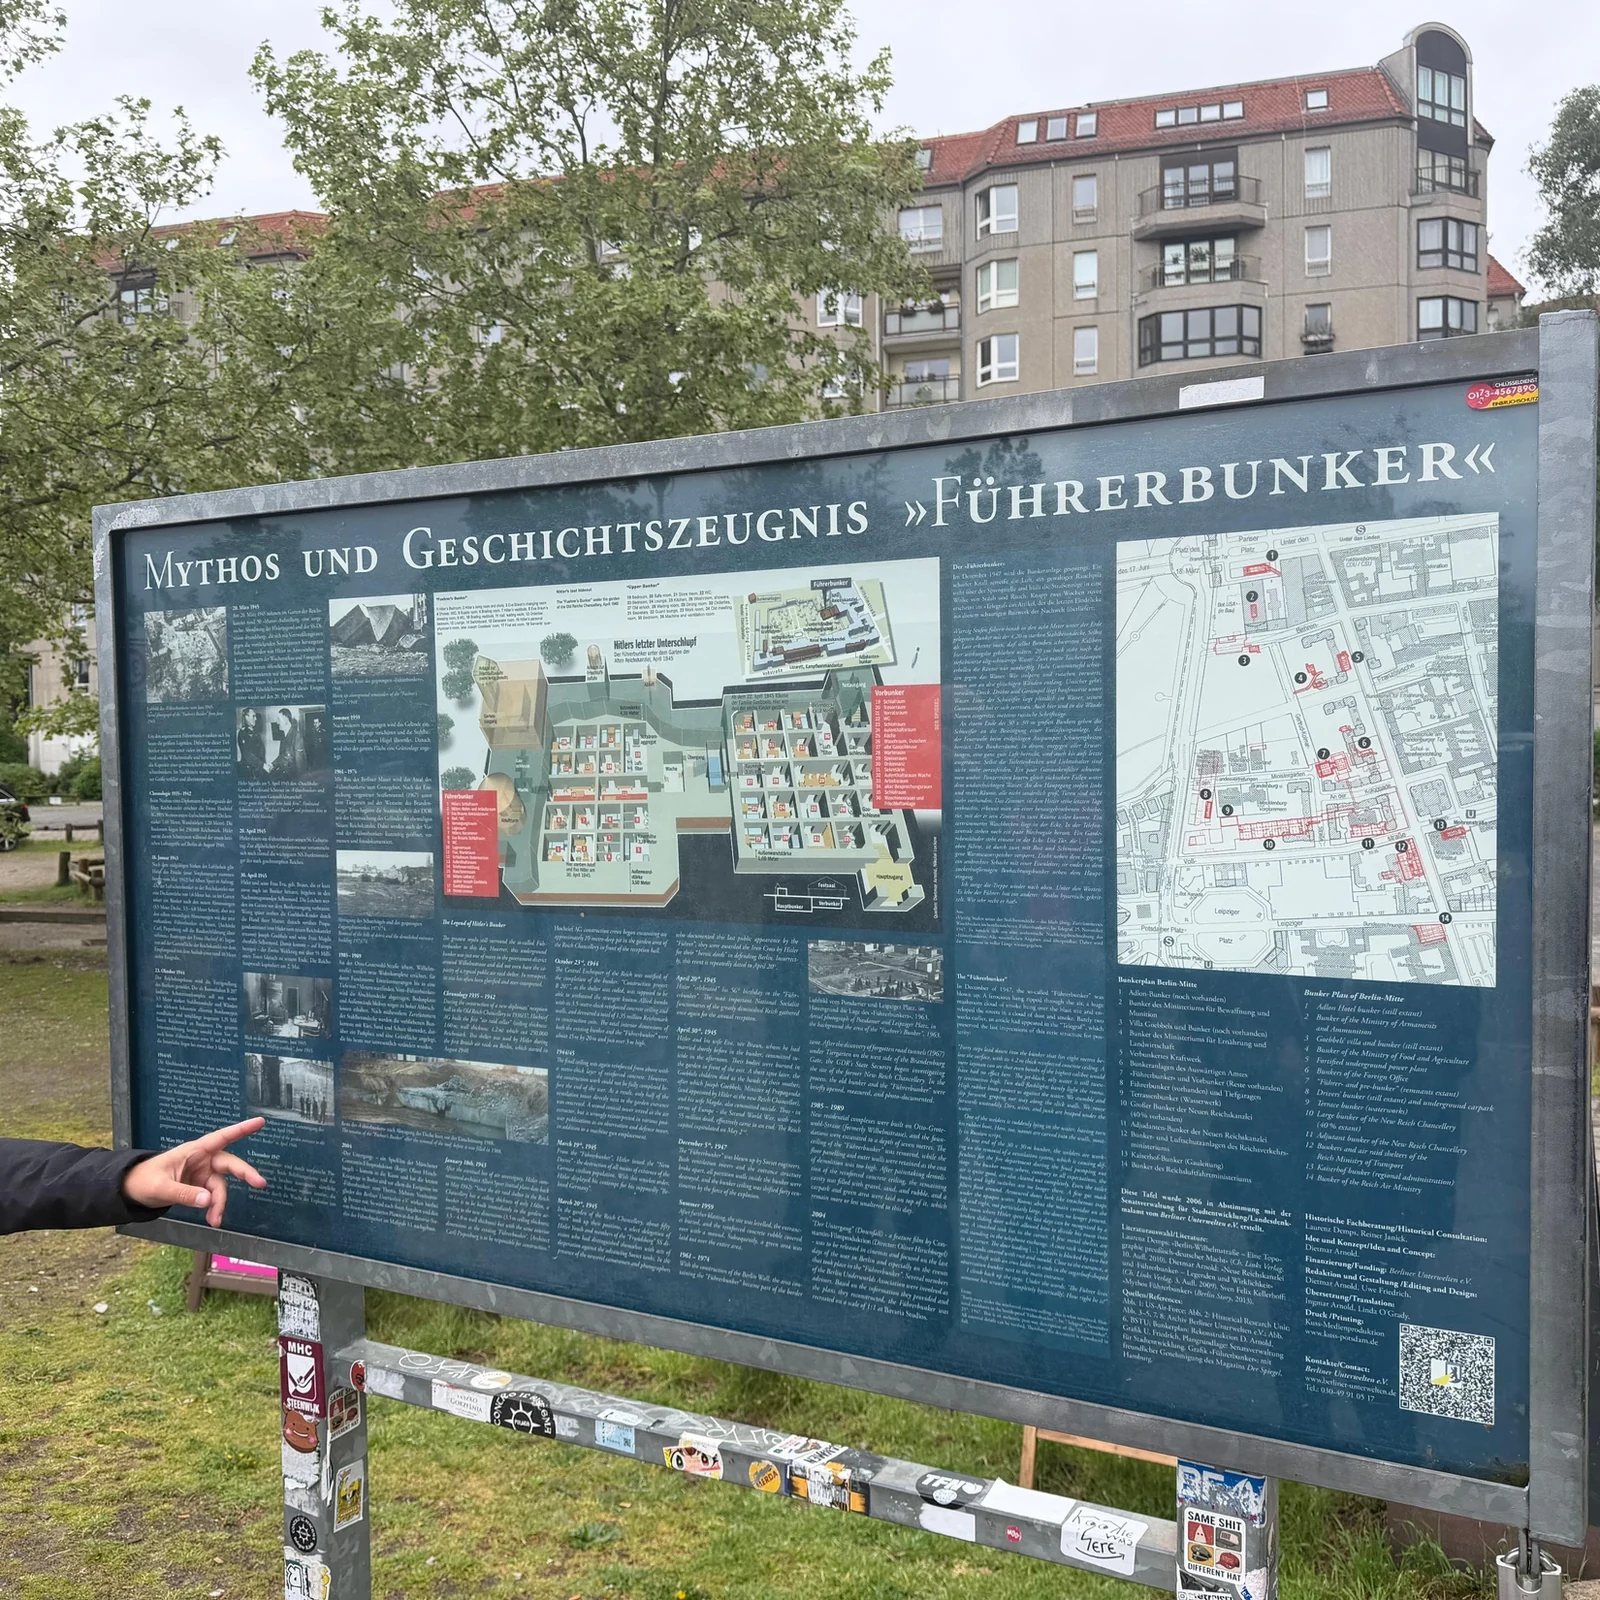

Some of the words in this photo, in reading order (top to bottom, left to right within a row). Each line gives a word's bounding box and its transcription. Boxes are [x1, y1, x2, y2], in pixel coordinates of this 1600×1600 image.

[1493, 378, 1538, 388] CHLÜSSELDIENST
[1468, 384, 1536, 399] 0173-4567890
[144, 549, 280, 591] MYTHOS
[304, 542, 378, 578] UND
[401, 500, 870, 570] GESCHICHTSZEUGNIS
[1280, 537, 1297, 546] Unter
[1299, 536, 1309, 544] den
[813, 579, 848, 588] Führerbunker
[614, 640, 634, 650] Hitlers
[636, 639, 655, 649] letzter
[657, 636, 697, 648] Unterschlupf
[1277, 920, 1303, 928] Leipziger
[1118, 976, 1155, 985] Bunkerplan
[1157, 979, 1197, 988] Berlin-Mitte
[1304, 989, 1330, 998] Bunker
[1331, 991, 1348, 999] Plan
[1350, 992, 1358, 1001] of
[1359, 992, 1404, 1002] Berlin-Mitte
[1358, 1006, 1380, 1015] bunker
[1188, 1024, 1210, 1033] Bunker
[1346, 1060, 1387, 1070] underground
[1388, 1064, 1408, 1072] power
[1410, 1065, 1428, 1074] plant
[1153, 1102, 1175, 1112] Bunker
[1188, 1106, 1208, 1115] Neuen
[1210, 1109, 1253, 1121] Reichskanzlei
[1317, 1153, 1334, 1162] Reich
[1336, 1156, 1363, 1166] Ministry
[1373, 1159, 1404, 1170] Transport
[1121, 1188, 1138, 1197] Diese
[1142, 1190, 1157, 1199] Tafel
[1162, 1194, 1181, 1202] wurde
[1218, 1201, 1260, 1215] Abstimmung
[1264, 1208, 1276, 1216] mit
[1280, 1209, 1291, 1218] der
[1305, 1213, 1344, 1225] Historische
[1436, 1230, 1488, 1243] Consultation:
[1305, 1223, 1331, 1233] Laurenz
[1360, 1230, 1382, 1239] Reiner
[1389, 1267, 1416, 1277] Berliner
[1418, 1271, 1458, 1283] Unterwelten
[288, 1341, 312, 1356] MHC
[1305, 1356, 1370, 1373] Kontakte/Contact:
[1305, 1365, 1332, 1376] Berliner
[1334, 1369, 1375, 1384] Unterwelten
[286, 1398, 320, 1414] STEENWIJK
[1188, 1511, 1215, 1526] SAME
[1219, 1518, 1242, 1530] SHIT
[1188, 1562, 1225, 1578] DIFFERENT
[1227, 1572, 1241, 1582] HAT
